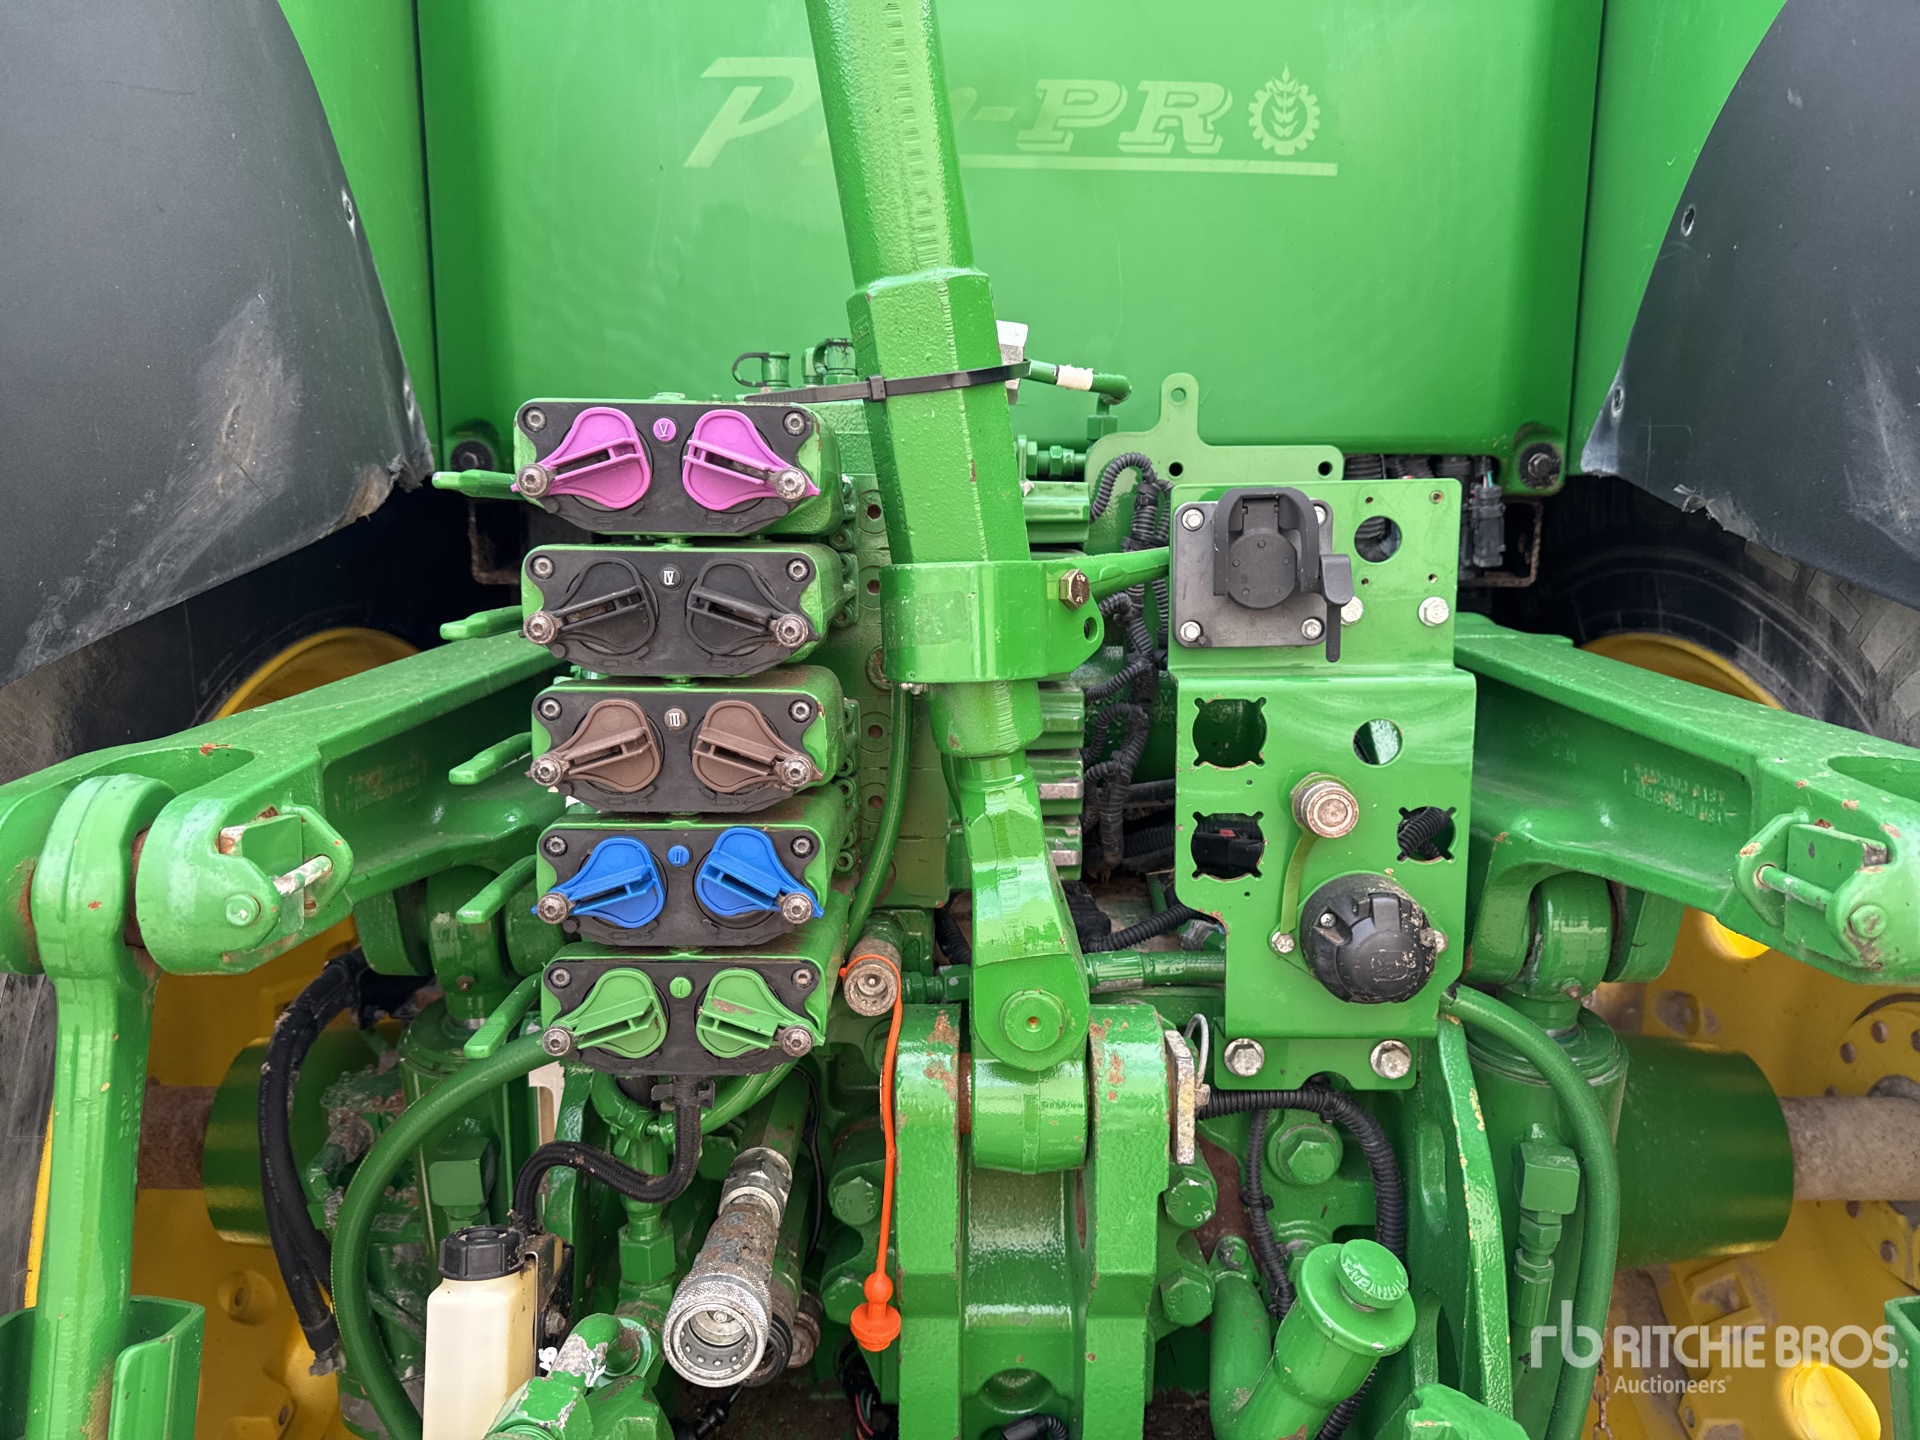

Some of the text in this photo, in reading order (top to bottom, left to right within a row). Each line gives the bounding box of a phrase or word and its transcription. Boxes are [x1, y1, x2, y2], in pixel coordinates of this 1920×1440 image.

[658, 422, 670, 438] V
[663, 570, 675, 585] IV
[668, 712, 681, 727] III
